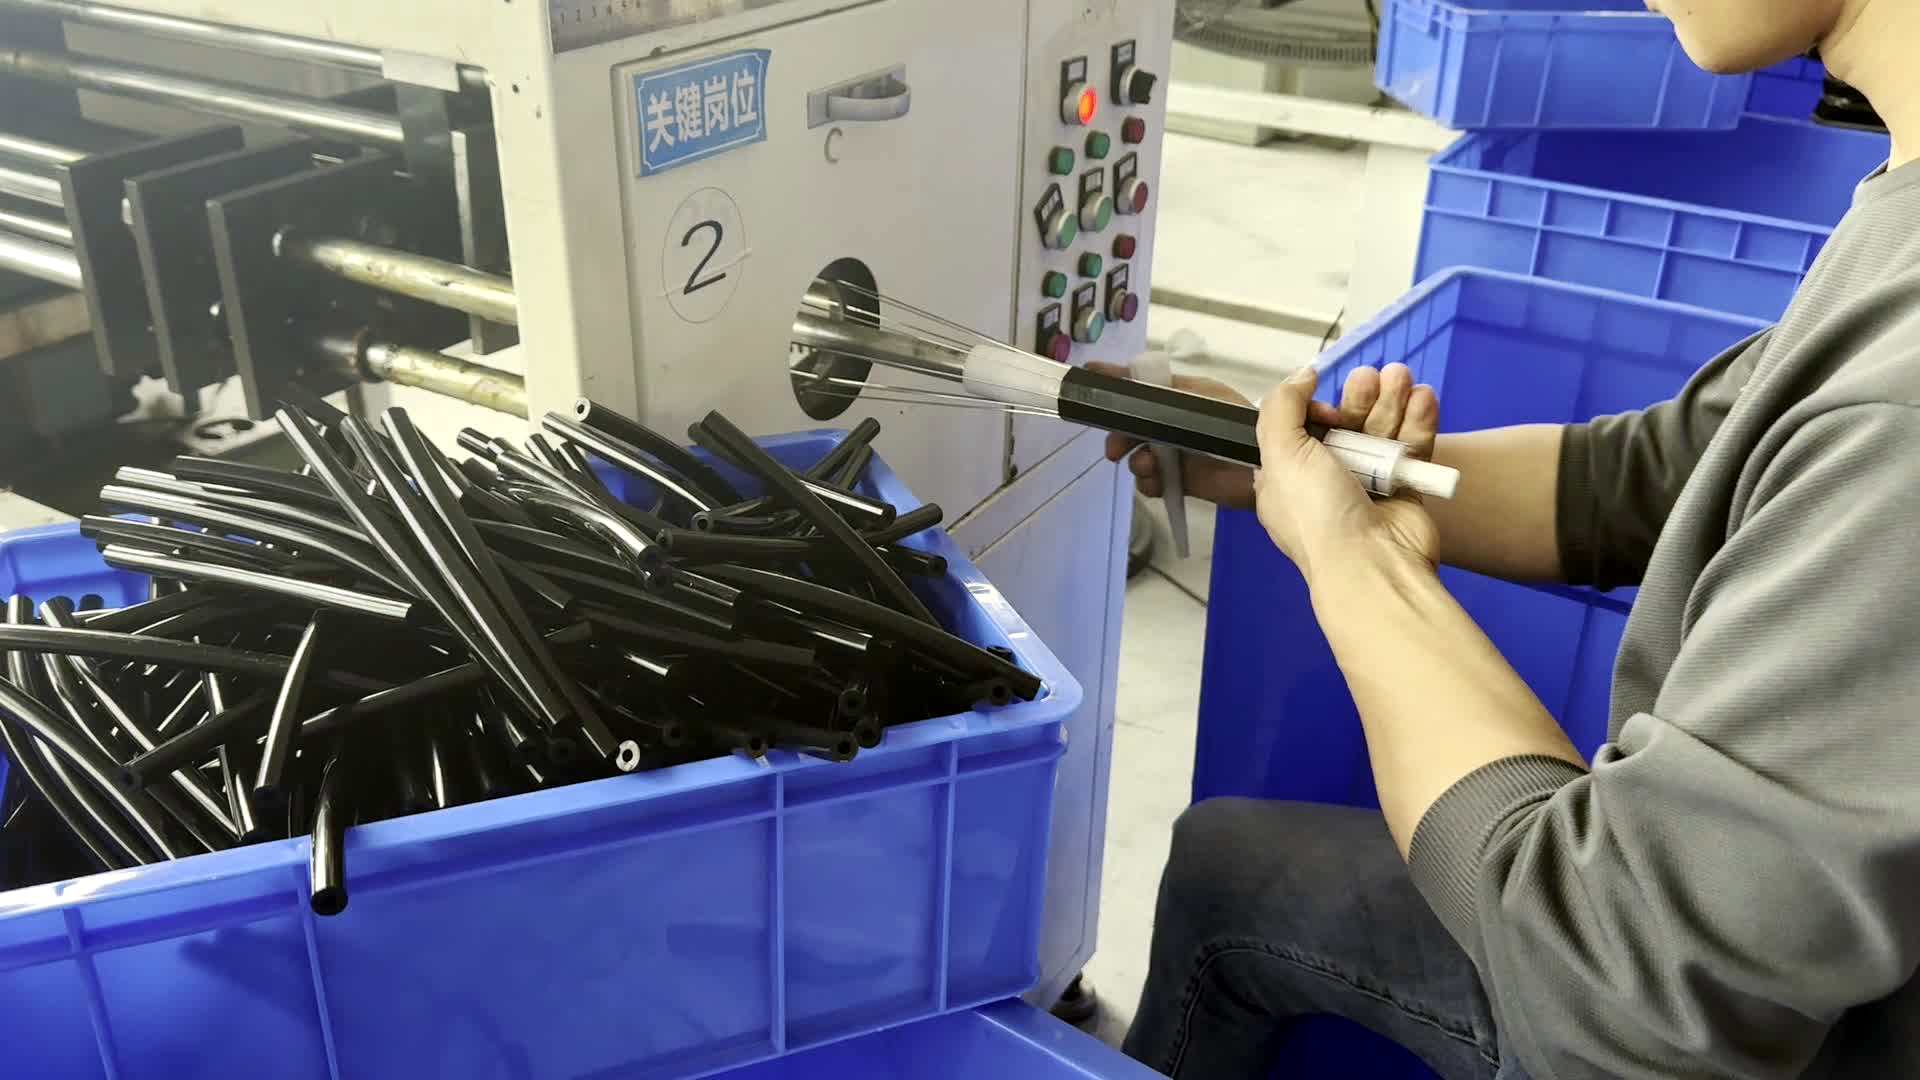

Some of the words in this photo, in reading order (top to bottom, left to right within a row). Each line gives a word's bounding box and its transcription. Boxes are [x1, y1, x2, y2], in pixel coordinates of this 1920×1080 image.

[647, 69, 757, 152] 关键岗位
[681, 219, 727, 295] 2
